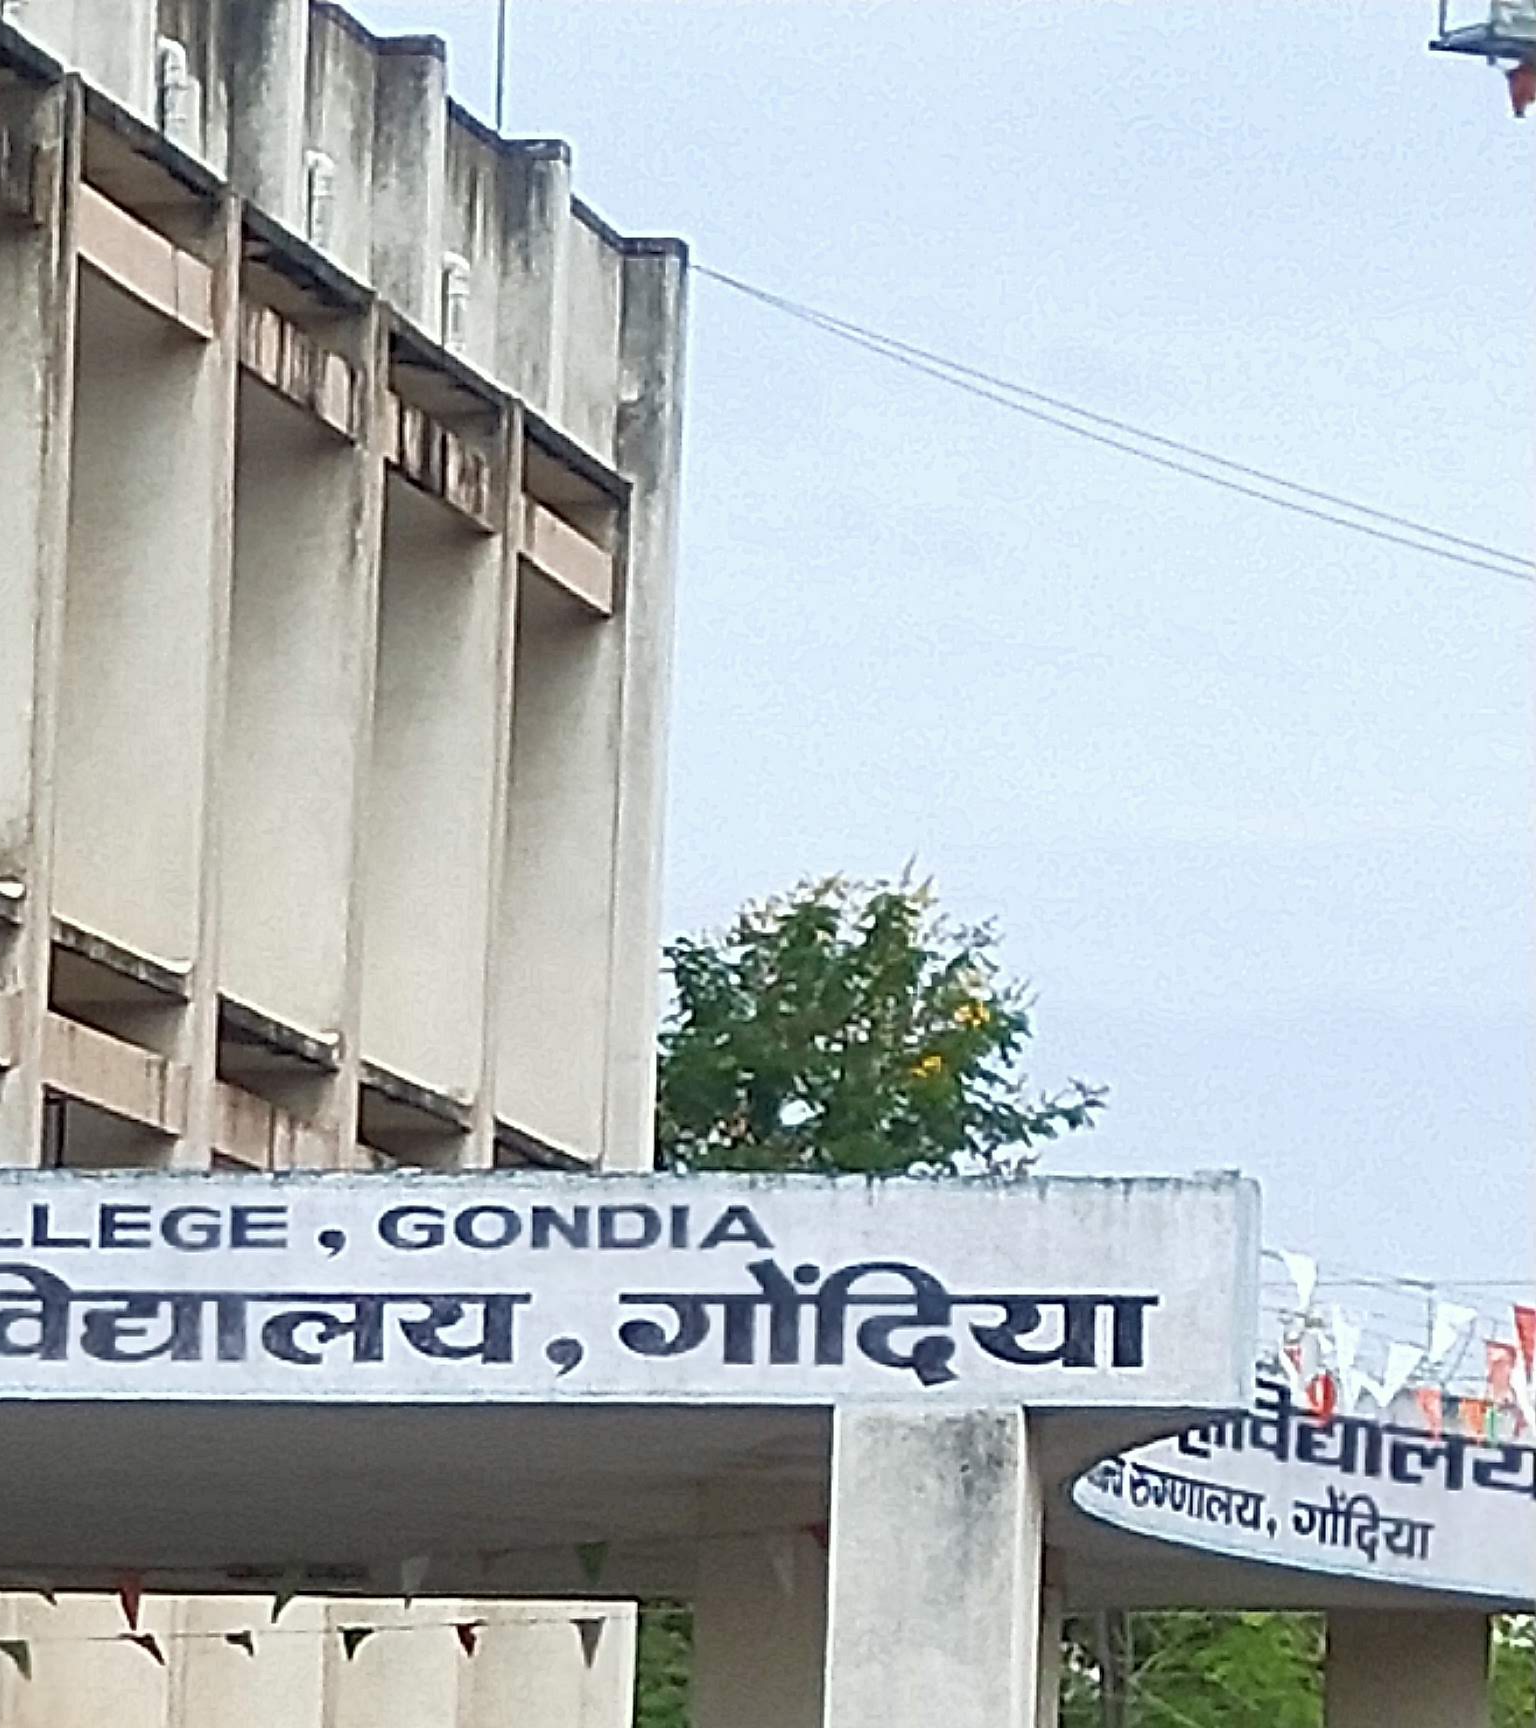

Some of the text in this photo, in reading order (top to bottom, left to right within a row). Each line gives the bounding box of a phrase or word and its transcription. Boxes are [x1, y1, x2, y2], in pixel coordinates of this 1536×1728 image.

[377, 1204, 775, 1251] GONDIA
[617, 1257, 1160, 1388] गोंदिया
[1292, 1484, 1435, 1562] गोंदिया
